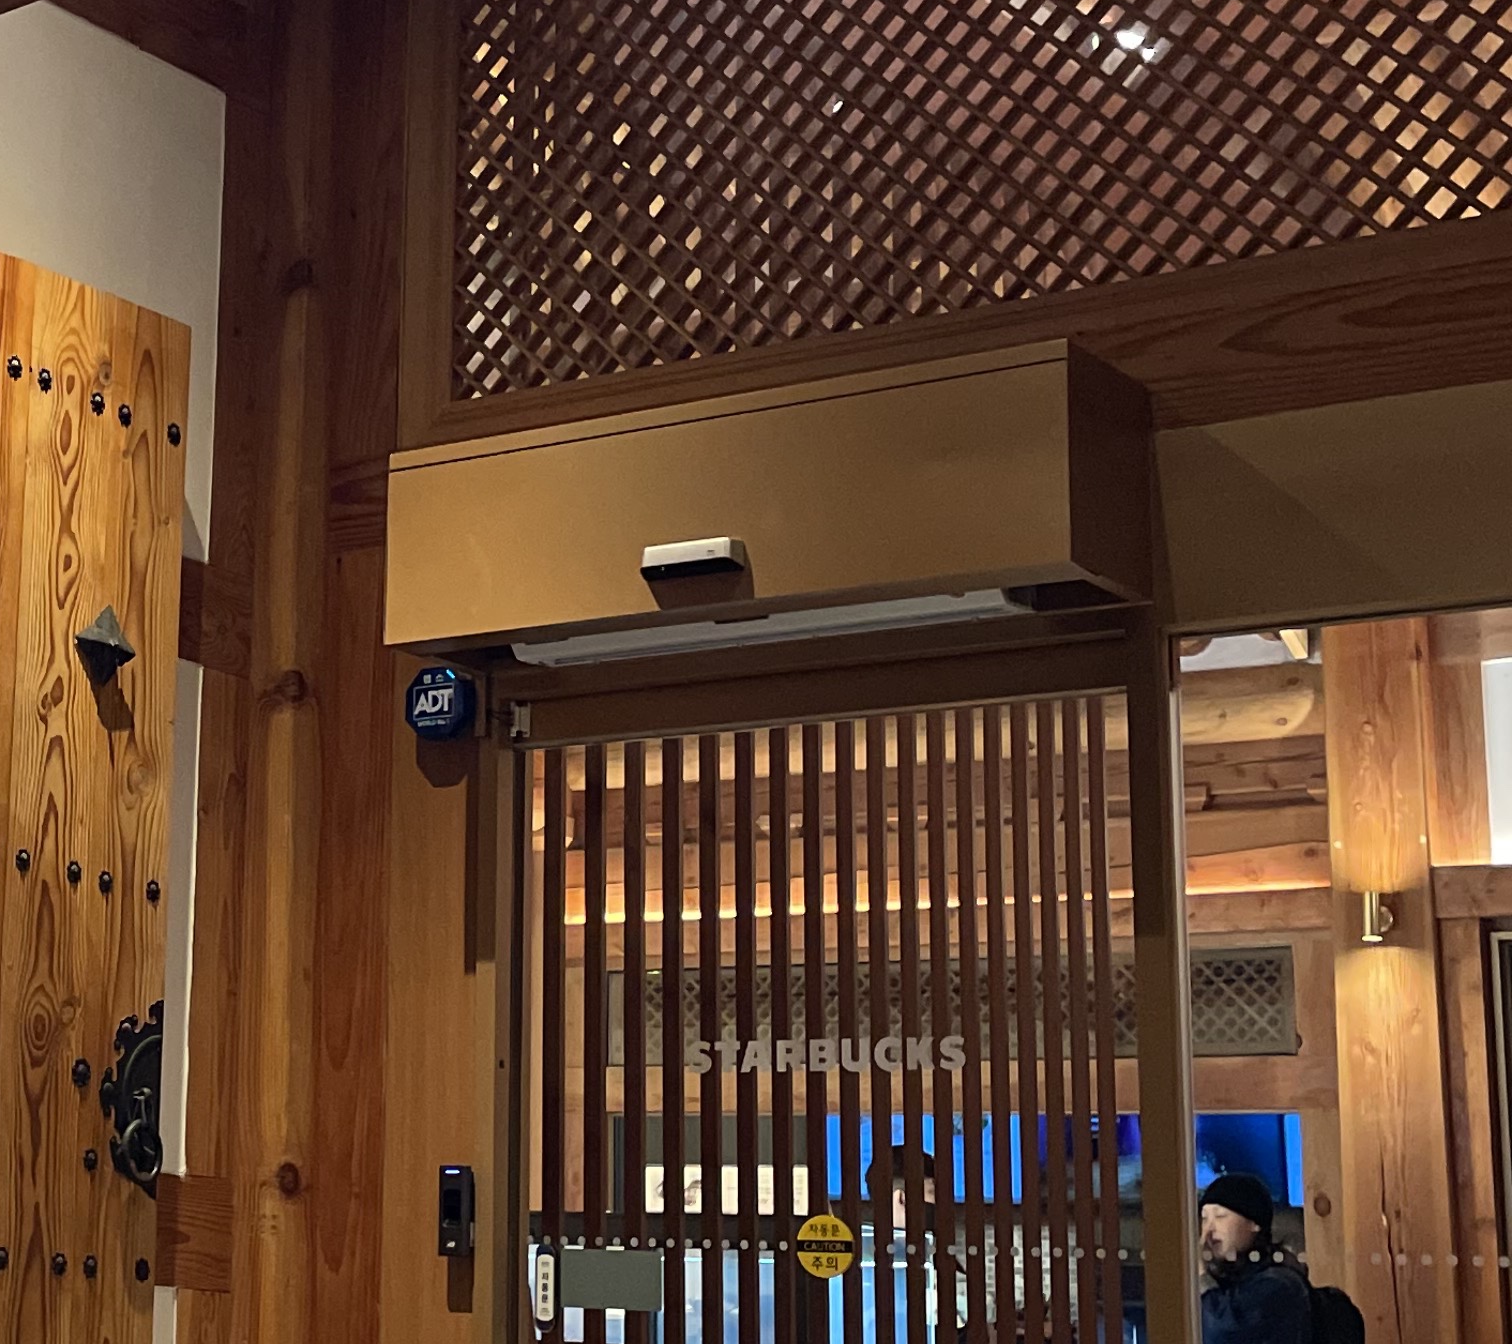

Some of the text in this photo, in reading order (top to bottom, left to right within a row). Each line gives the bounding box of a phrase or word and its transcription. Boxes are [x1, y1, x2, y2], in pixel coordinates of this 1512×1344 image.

[413, 688, 454, 715] ADT
[689, 1035, 967, 1074] STARBUCKS
[809, 1223, 840, 1237] 자동문
[803, 1240, 846, 1252] CAUTION
[811, 1256, 838, 1271] 주의
